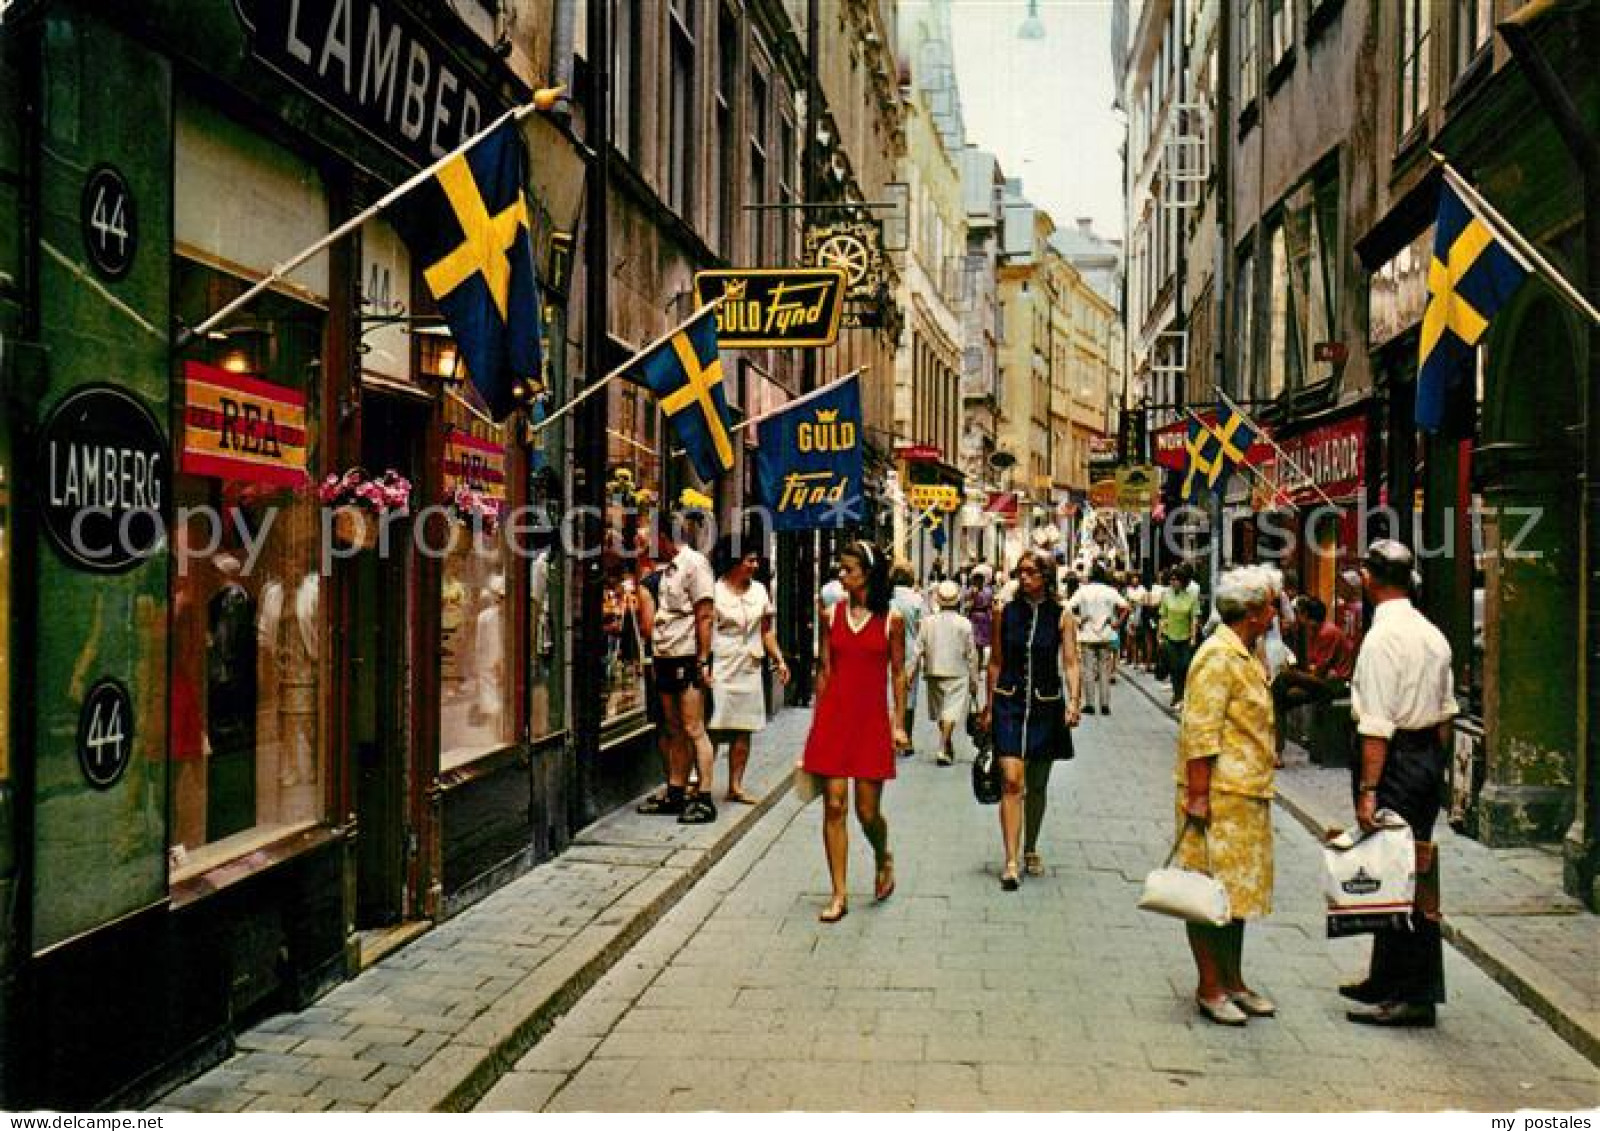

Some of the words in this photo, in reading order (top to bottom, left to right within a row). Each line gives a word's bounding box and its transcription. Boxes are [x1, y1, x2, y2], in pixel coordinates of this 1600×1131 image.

[287, 0, 481, 158] LAMBER
[91, 186, 128, 256] 44
[765, 280, 834, 335] Fynd
[218, 397, 282, 458] REA
[797, 422, 855, 452] GULD
[50, 440, 161, 511] LAMBERG
[777, 471, 848, 512] Fynd
[87, 699, 124, 765] 44
